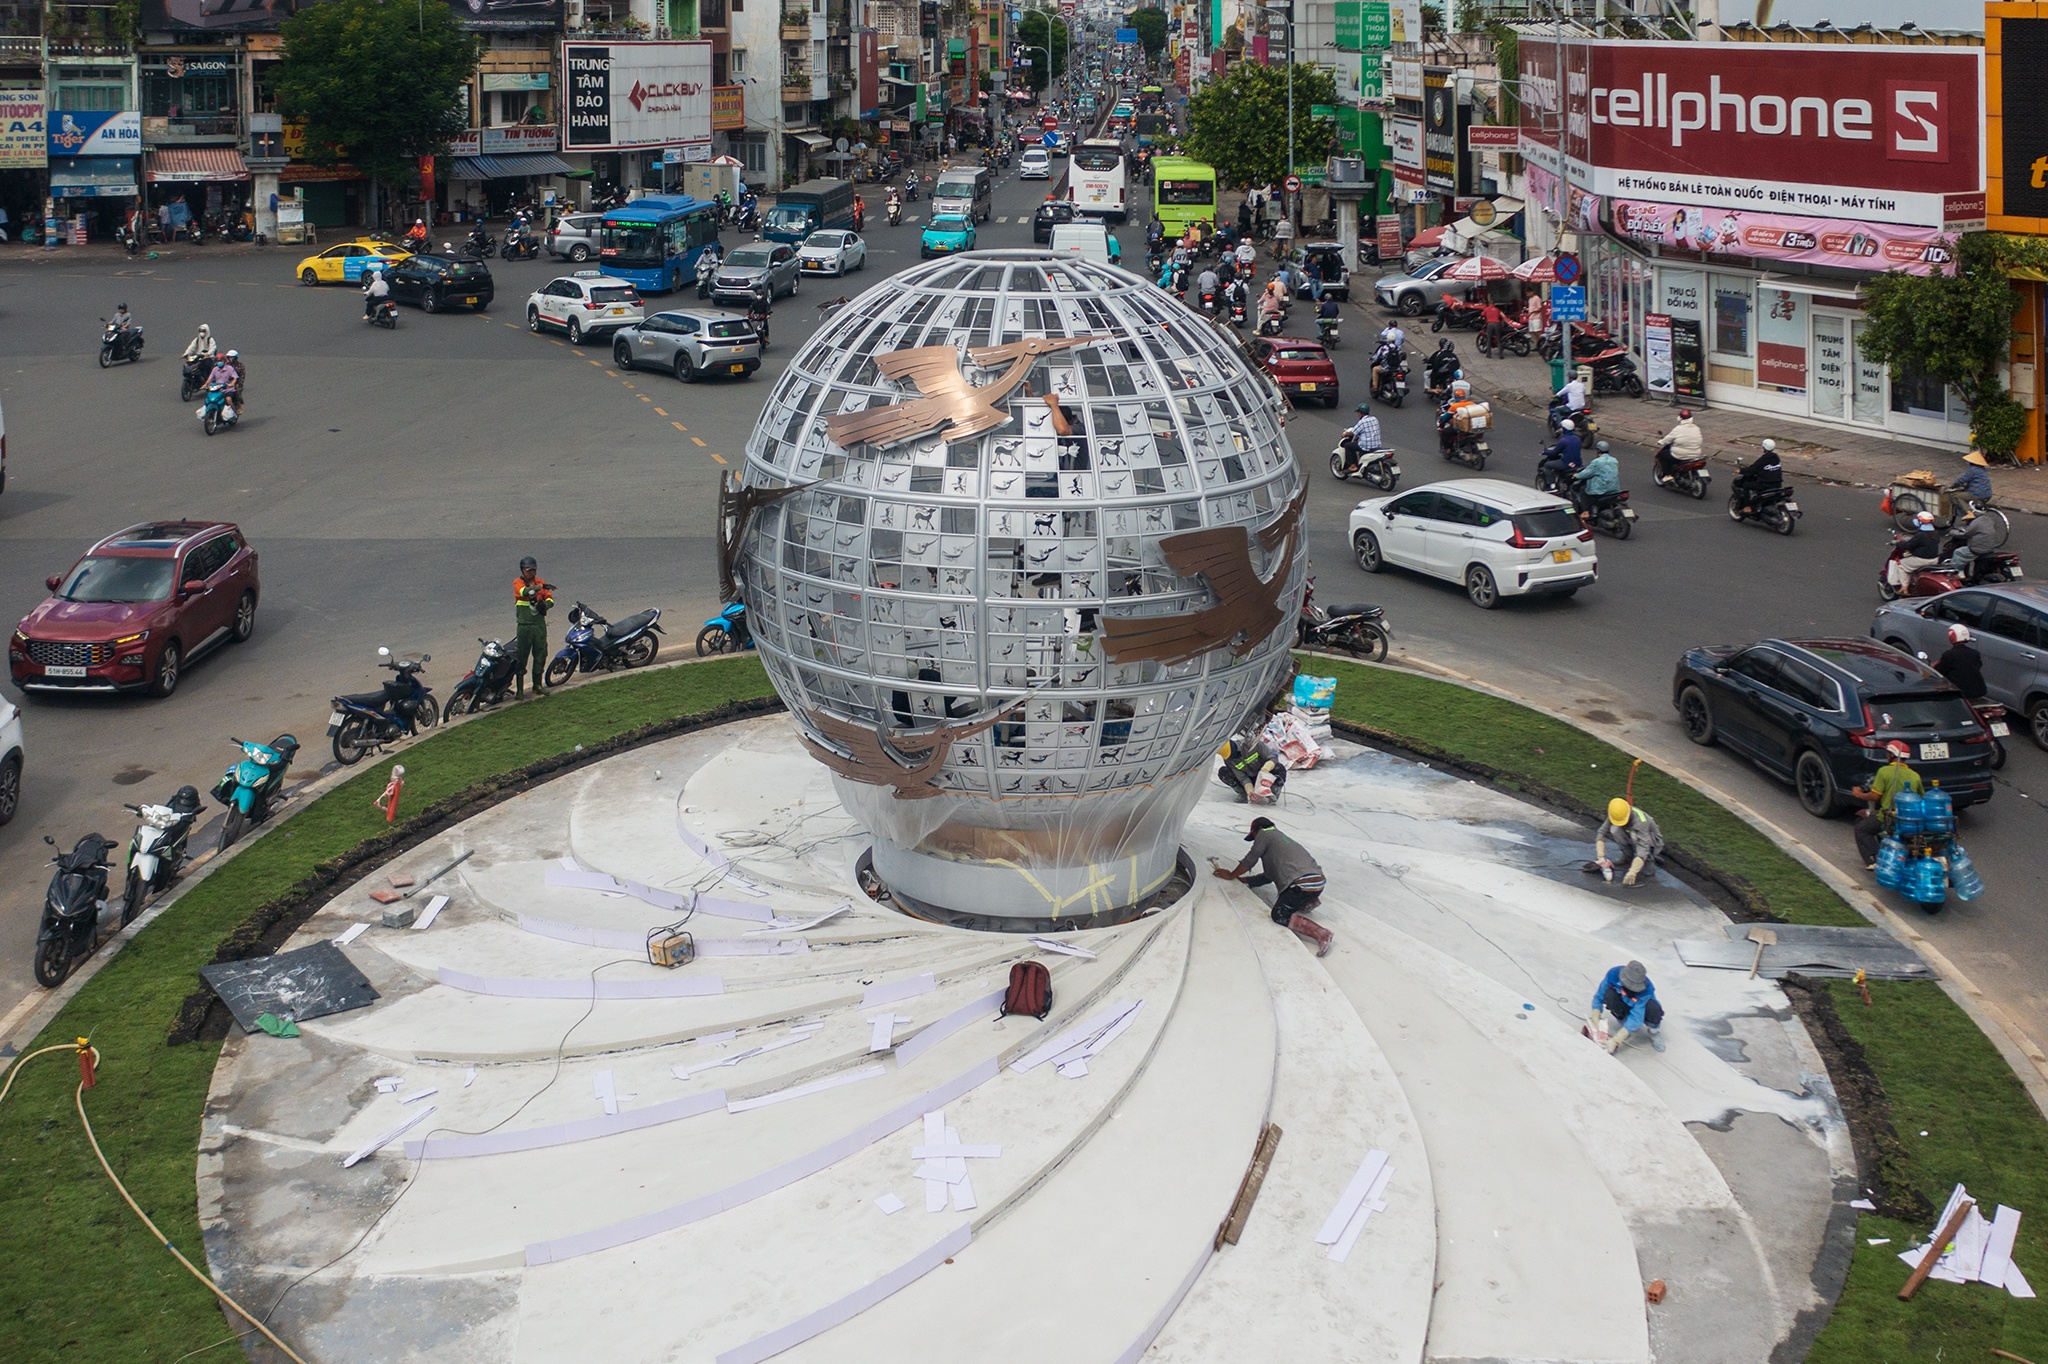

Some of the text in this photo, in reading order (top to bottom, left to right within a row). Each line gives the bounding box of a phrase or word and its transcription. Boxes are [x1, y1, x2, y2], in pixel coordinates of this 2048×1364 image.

[1367, 14, 1384, 23] ĐIỆN
[191, 62, 226, 70] SAIGON
[570, 59, 609, 70] TRUNG
[576, 74, 604, 88] TÂM
[648, 83, 703, 97] CLICKBUY
[576, 91, 603, 107] BẢO
[571, 111, 608, 127] HÀNH
[9, 121, 44, 132] A4
[102, 126, 139, 138] AN HÒA
[52, 133, 85, 148] Tiger
[504, 130, 520, 139] TIN
[1619, 176, 1630, 188] HỆ
[1633, 177, 1666, 191] THỐNG
[1669, 181, 1689, 193] BÁN
[1691, 181, 1702, 194] LẺ
[1705, 184, 1731, 196] TOÀN
[1734, 185, 1764, 199] QUỐC
[1770, 190, 1795, 204] ĐIỆN
[1798, 193, 1831, 206] THOẠI
[1842, 195, 1865, 208] MÁY
[1868, 197, 1895, 210] TÍNH
[1786, 233, 1797, 246] 3
[1928, 248, 1950, 262] 10%
[1669, 287, 1696, 297] THU CŨ
[1667, 297, 1698, 310] ĐỔI MỚI
[1822, 349, 1840, 358] TÂM
[1863, 369, 1879, 379] MÁY
[1861, 382, 1879, 393] TÍNH
